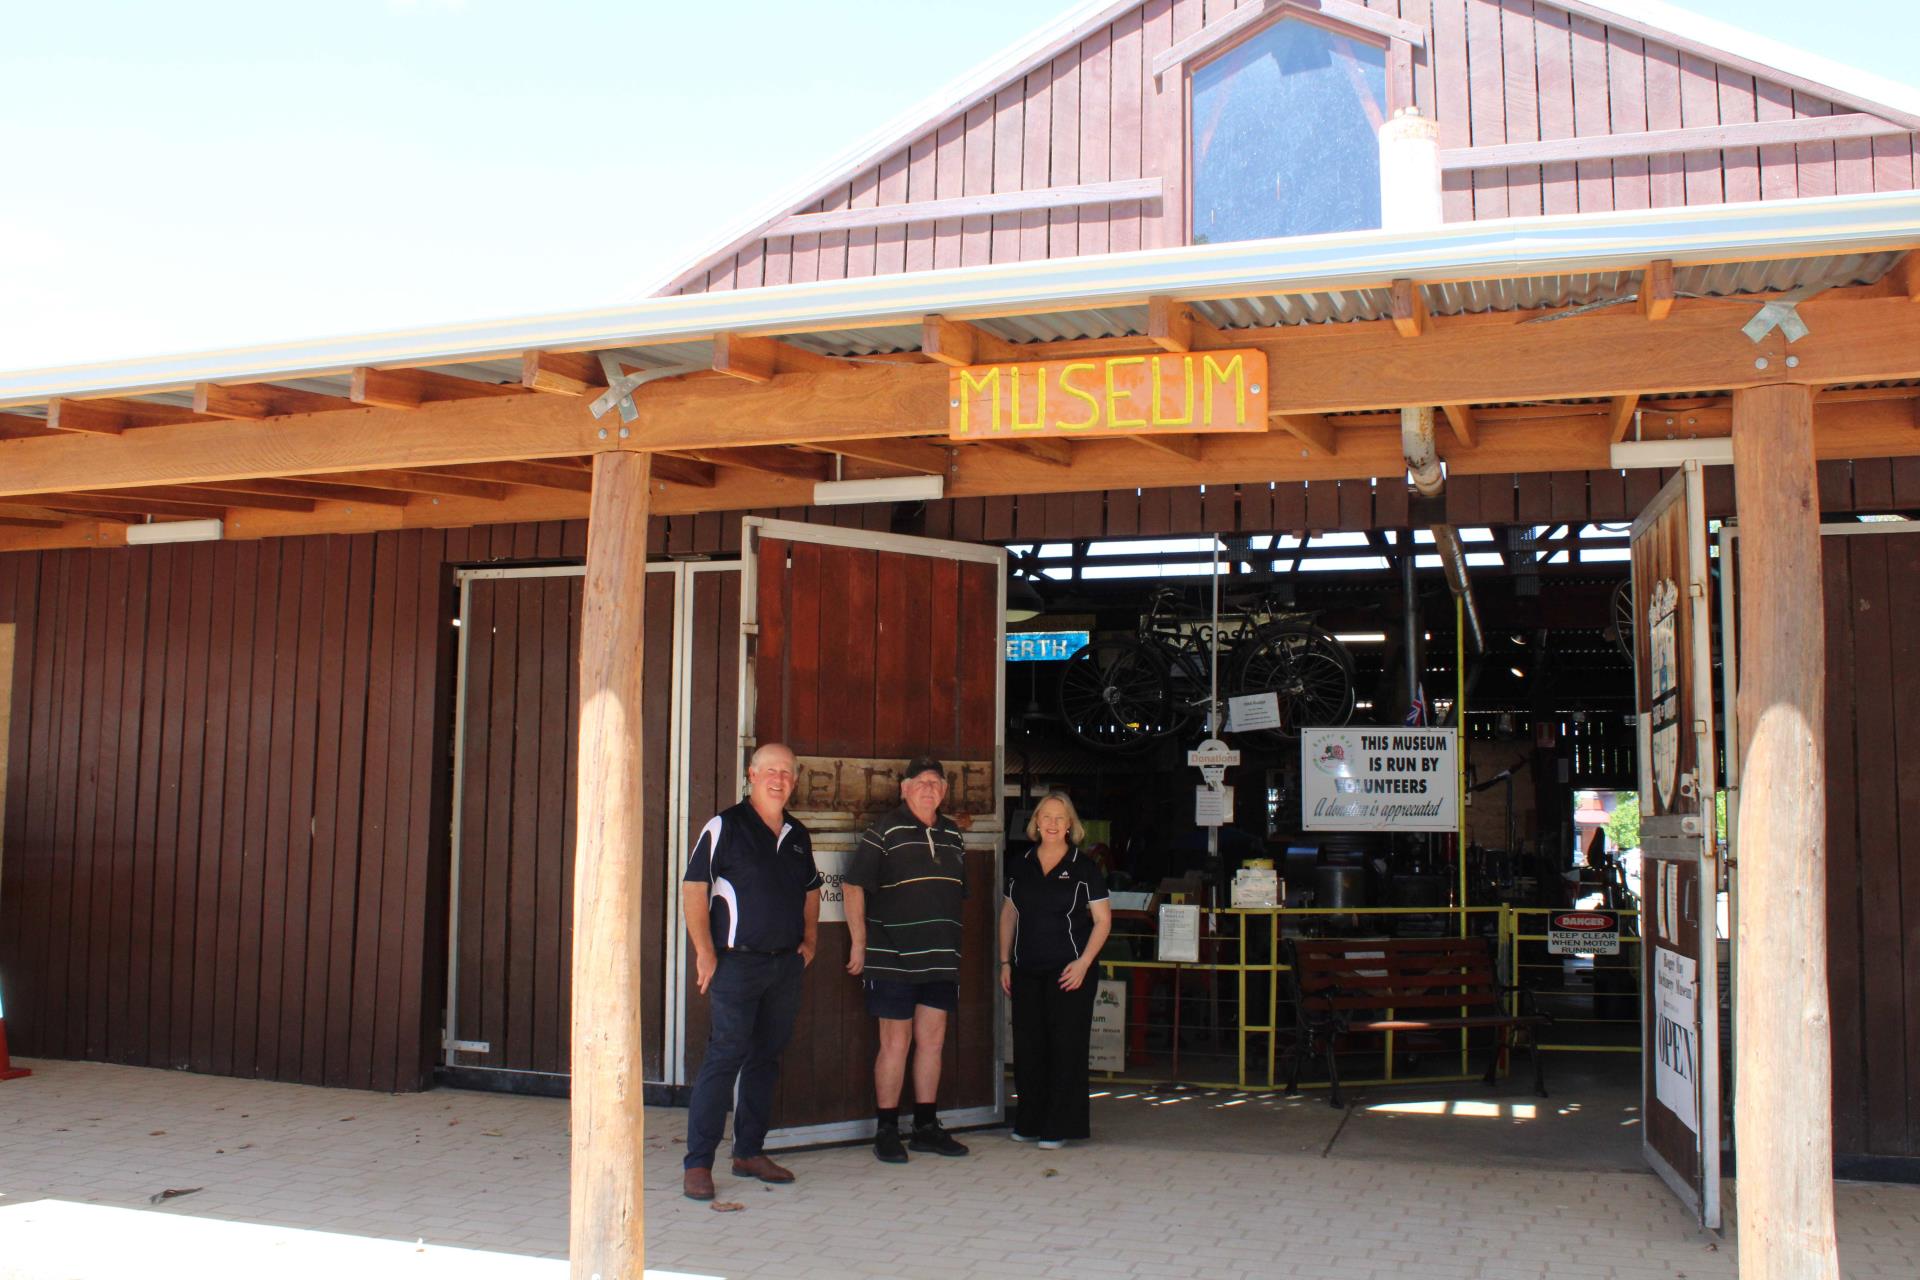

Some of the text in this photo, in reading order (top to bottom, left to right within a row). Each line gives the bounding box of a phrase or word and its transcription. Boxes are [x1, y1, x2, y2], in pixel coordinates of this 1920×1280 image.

[960, 353, 1244, 433] MUSEUM
[1006, 639, 1068, 657] ERTH
[1361, 735, 1389, 751] THIS
[1392, 735, 1447, 751] MUSEUM
[1191, 753, 1238, 763] Donations
[1369, 757, 1382, 772] IS
[1387, 757, 1416, 772] RUN
[1421, 757, 1439, 772] BY
[1313, 797, 1328, 817] A
[1369, 799, 1380, 817] is
[1380, 797, 1444, 822] appreciated
[817, 871, 846, 888] Roge
[819, 889, 844, 902] Mac
[1562, 917, 1605, 926] DANGER
[1658, 1012, 1694, 1085] OPEN
